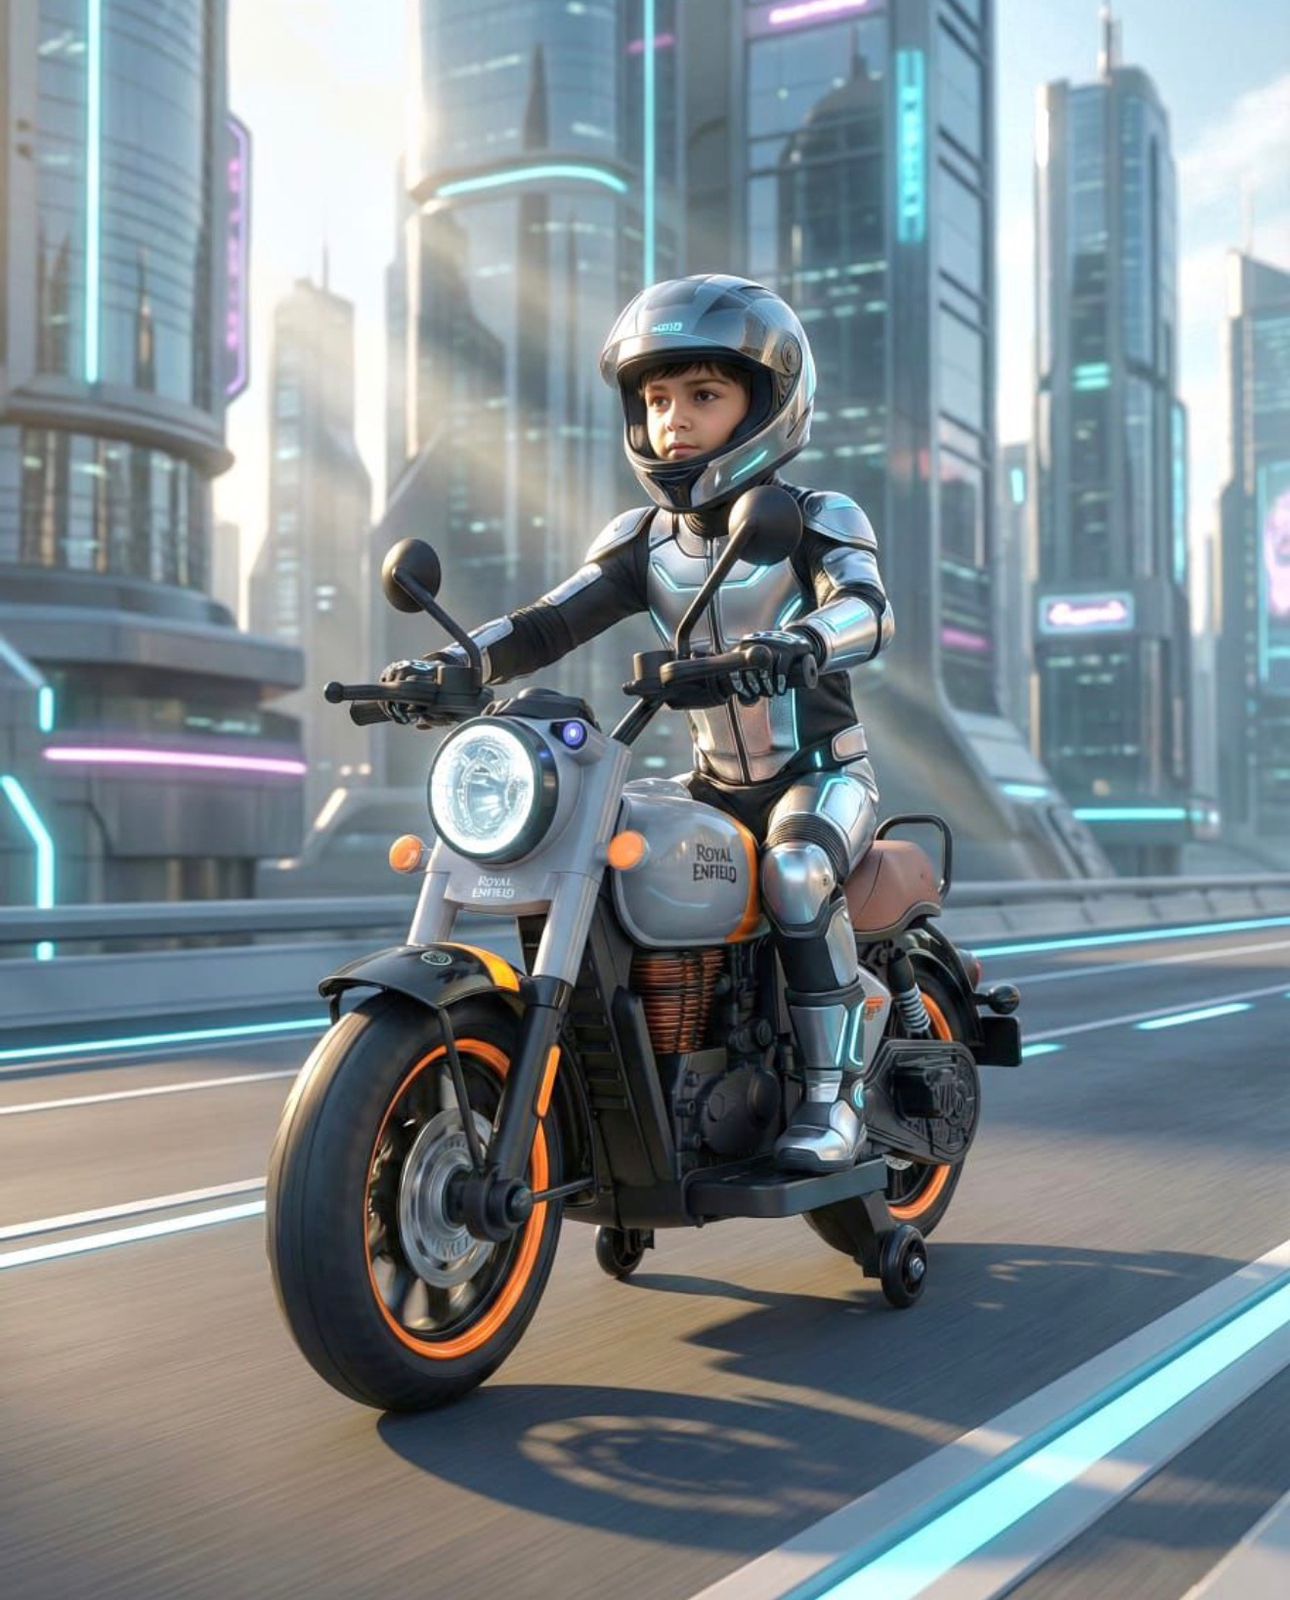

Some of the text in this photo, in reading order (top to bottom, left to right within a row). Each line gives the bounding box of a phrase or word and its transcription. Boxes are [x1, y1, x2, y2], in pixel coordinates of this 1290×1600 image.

[696, 844, 733, 862] ROYAL
[478, 876, 512, 887] ROYAL
[693, 863, 737, 884] ENFIELD
